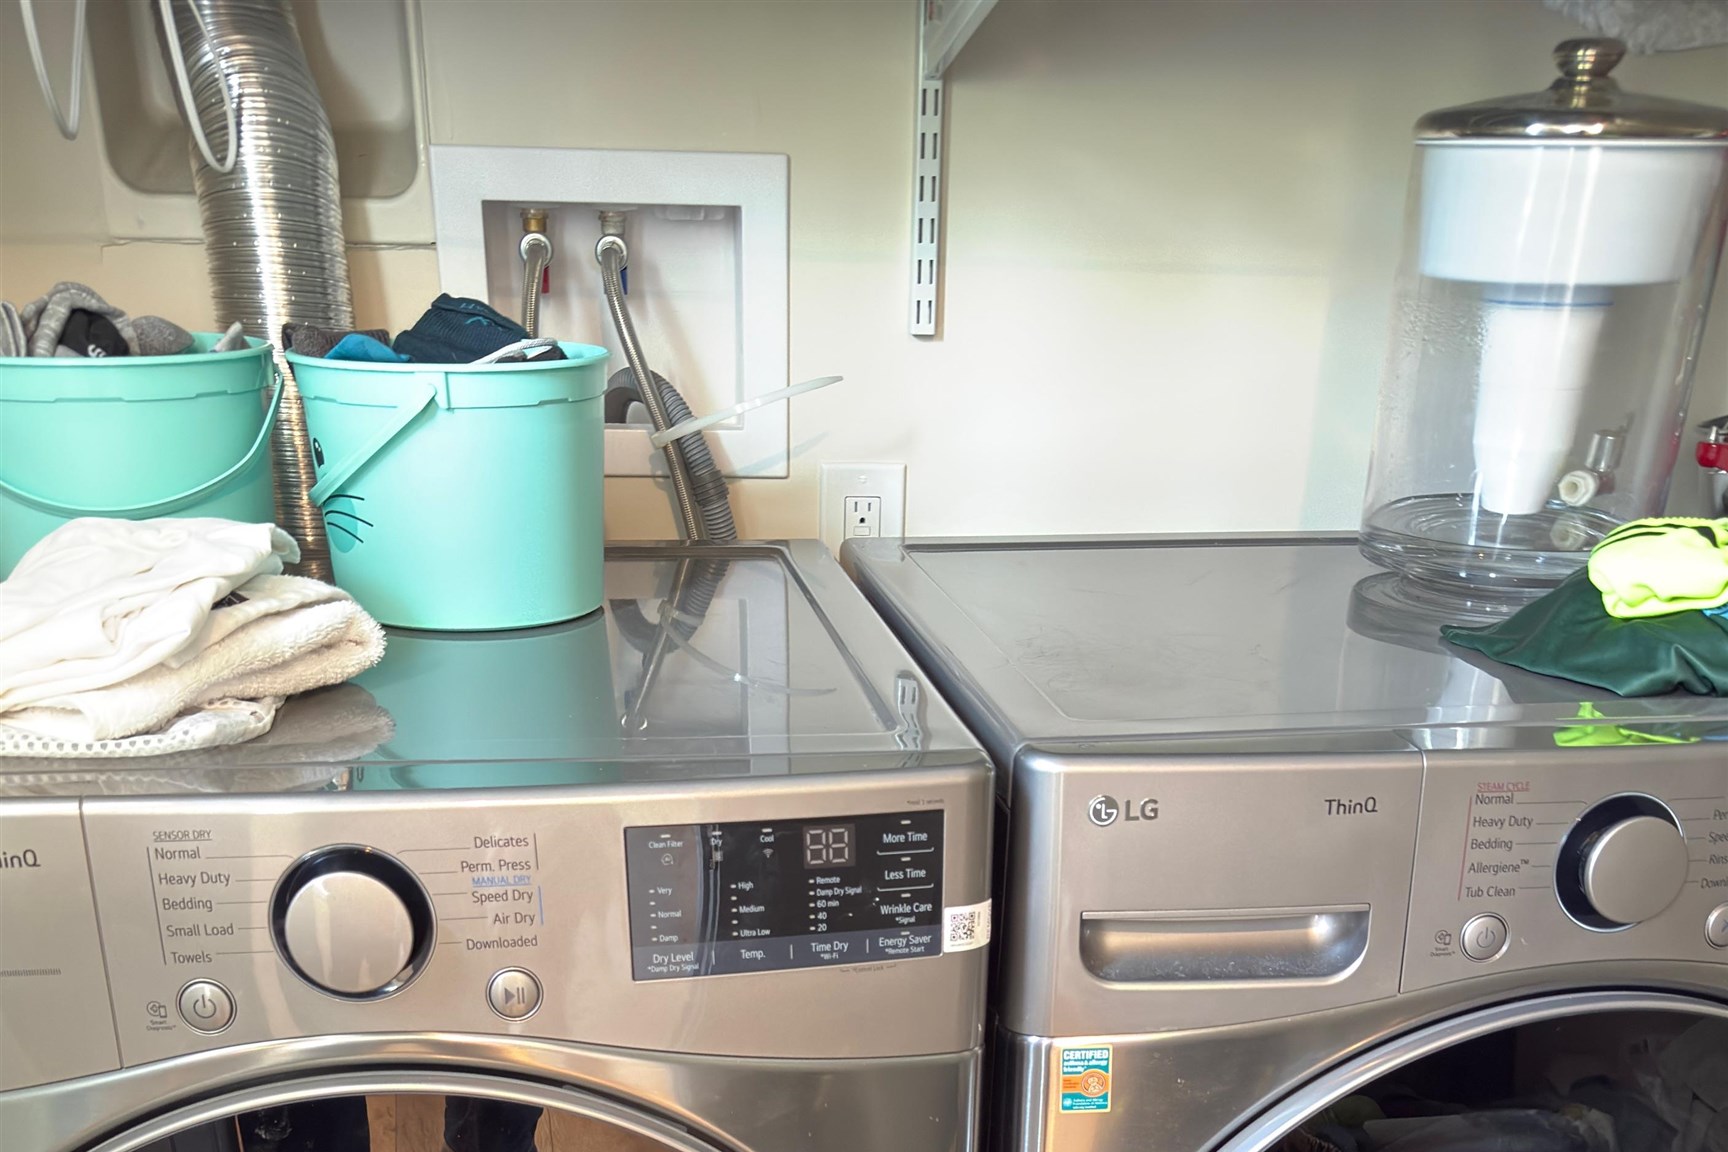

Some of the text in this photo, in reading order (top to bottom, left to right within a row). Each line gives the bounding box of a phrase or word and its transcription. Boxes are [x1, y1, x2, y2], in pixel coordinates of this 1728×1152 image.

[1477, 781, 1530, 791] STEAM CYCLE
[1475, 793, 1514, 805] Normal
[1124, 798, 1159, 821] LG
[1324, 796, 1379, 816] ThinQ
[1473, 815, 1533, 830] Heavy Duty
[153, 830, 212, 841] SENSOR DRY
[760, 834, 774, 844] Cool
[882, 832, 928, 844] More Time
[474, 835, 529, 849] Delicates
[648, 840, 684, 849] Clean Filter
[1470, 838, 1513, 852] Bedding
[154, 846, 201, 860] Normal
[460, 859, 532, 873] Perm. Press
[158, 870, 231, 888] Heavy Duty
[472, 874, 531, 885] MANUAL DRY
[884, 868, 926, 880] Less Time
[738, 881, 754, 892] High
[816, 876, 841, 885] Remote
[471, 889, 534, 906] Speed Dry
[657, 887, 673, 896] Very
[816, 886, 862, 897] Damp Dry Signal
[1464, 886, 1516, 898] Tub Clean
[162, 898, 214, 912] Bedding
[739, 905, 766, 914] Medium
[816, 900, 827, 908] 60
[880, 902, 933, 915] Wrinkle Care
[493, 912, 536, 926] Air Dry
[658, 910, 682, 919] Normal
[816, 912, 828, 920] 40
[166, 923, 234, 938] Small Load
[740, 928, 771, 938] Ultra Low
[817, 924, 828, 932] 20
[466, 935, 538, 951] Downloaded
[659, 934, 679, 943] Damp
[878, 934, 932, 948] Energy Saver
[810, 941, 849, 953] Time Dry
[170, 950, 213, 964] Towels
[652, 952, 694, 966] Dry Level
[740, 949, 766, 961] Temp.
[669, 964, 680, 973] Dry
[681, 962, 700, 972] Signal
[1063, 1050, 1109, 1060] CERTIFIED
